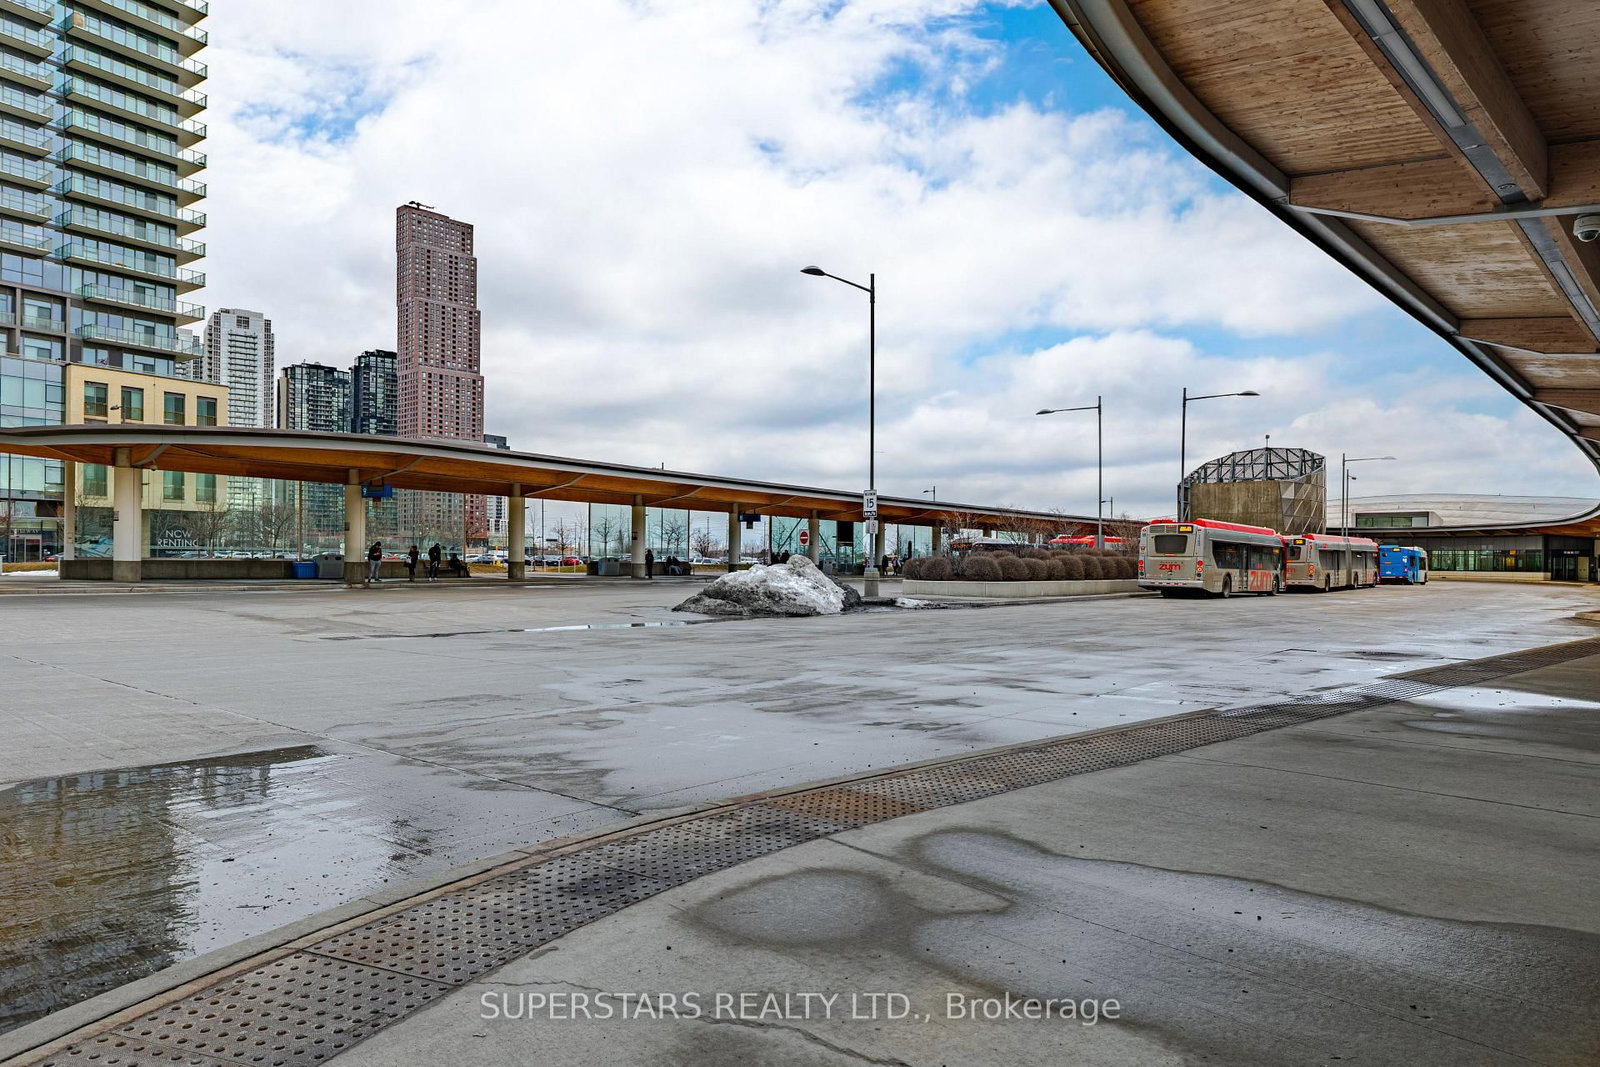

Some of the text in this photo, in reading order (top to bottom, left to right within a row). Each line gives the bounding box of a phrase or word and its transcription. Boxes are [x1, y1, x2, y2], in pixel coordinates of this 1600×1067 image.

[866, 498, 875, 508] 15
[165, 529, 193, 538] NOW
[157, 538, 199, 547] RENTING
